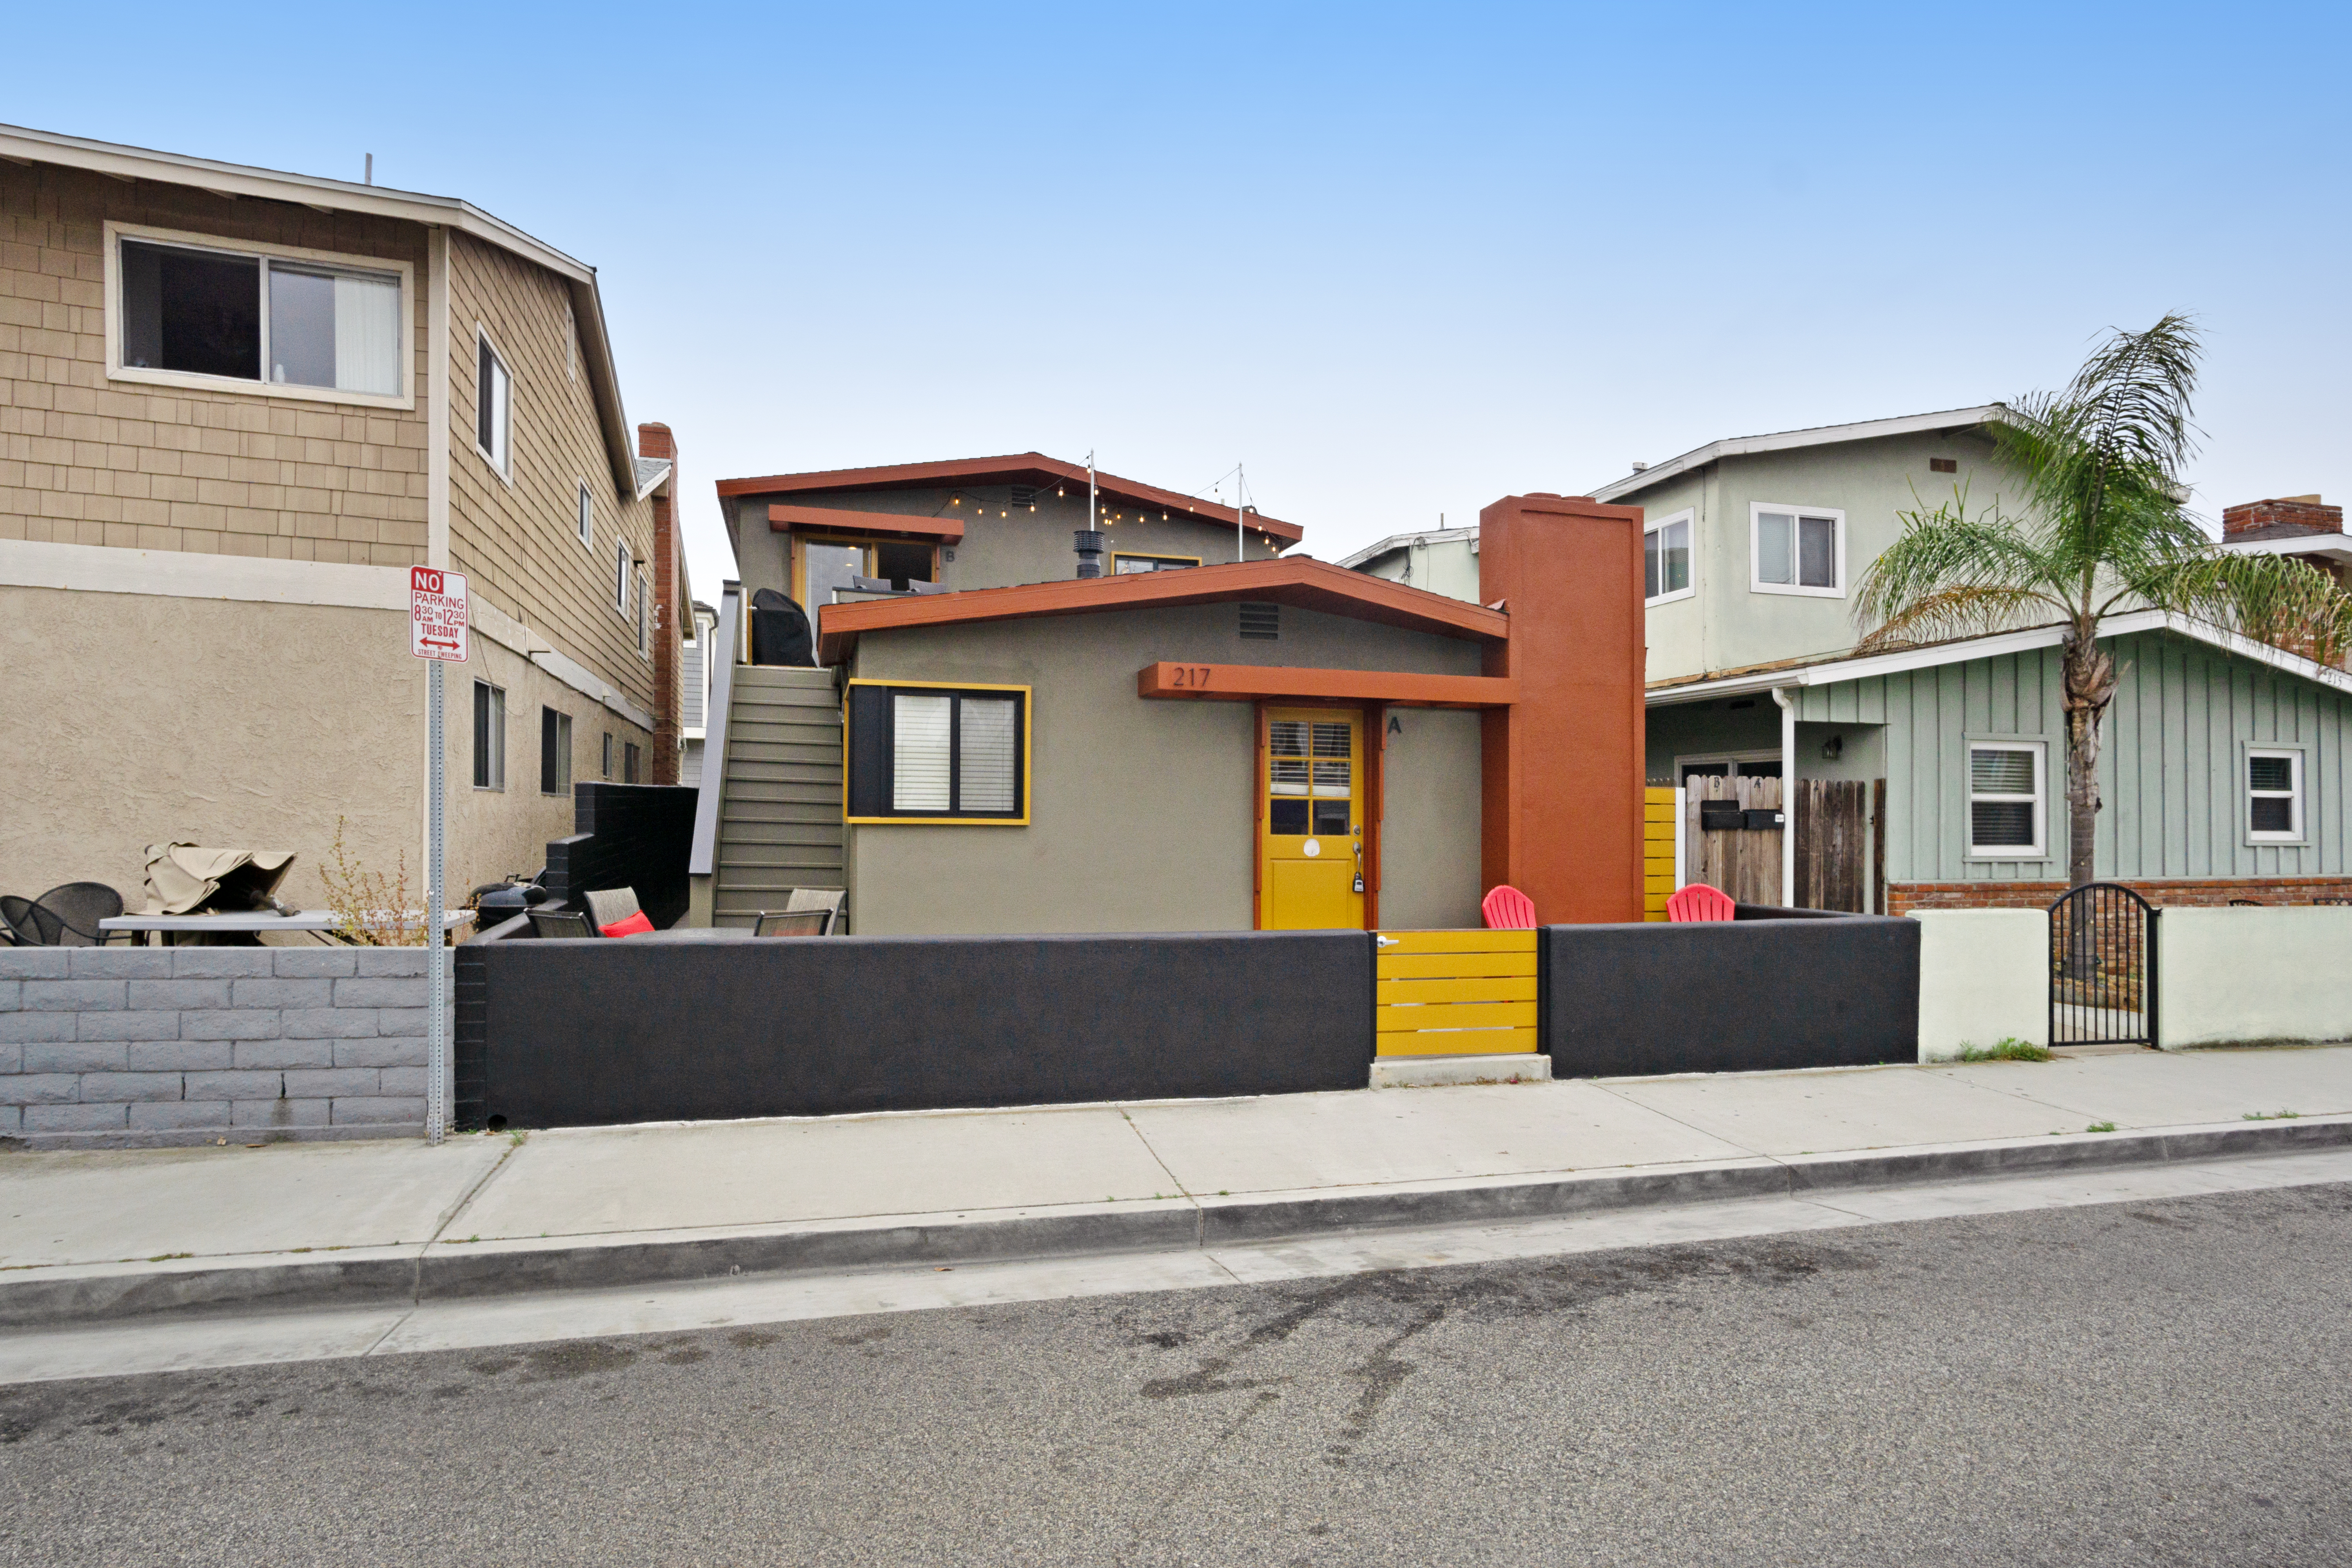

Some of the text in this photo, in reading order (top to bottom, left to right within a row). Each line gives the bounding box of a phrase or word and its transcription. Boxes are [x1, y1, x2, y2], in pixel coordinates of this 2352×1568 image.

[946, 550, 955, 562] B
[416, 572, 440, 591] NO
[415, 592, 464, 610] PARKING
[421, 623, 459, 639] TUESDAY
[438, 651, 462, 659] SWEEPING
[1174, 667, 1210, 687] 217
[2328, 672, 2342, 687] 215
[1388, 716, 1402, 733] A
[1714, 776, 1720, 788] B
[1754, 777, 1761, 788] A
